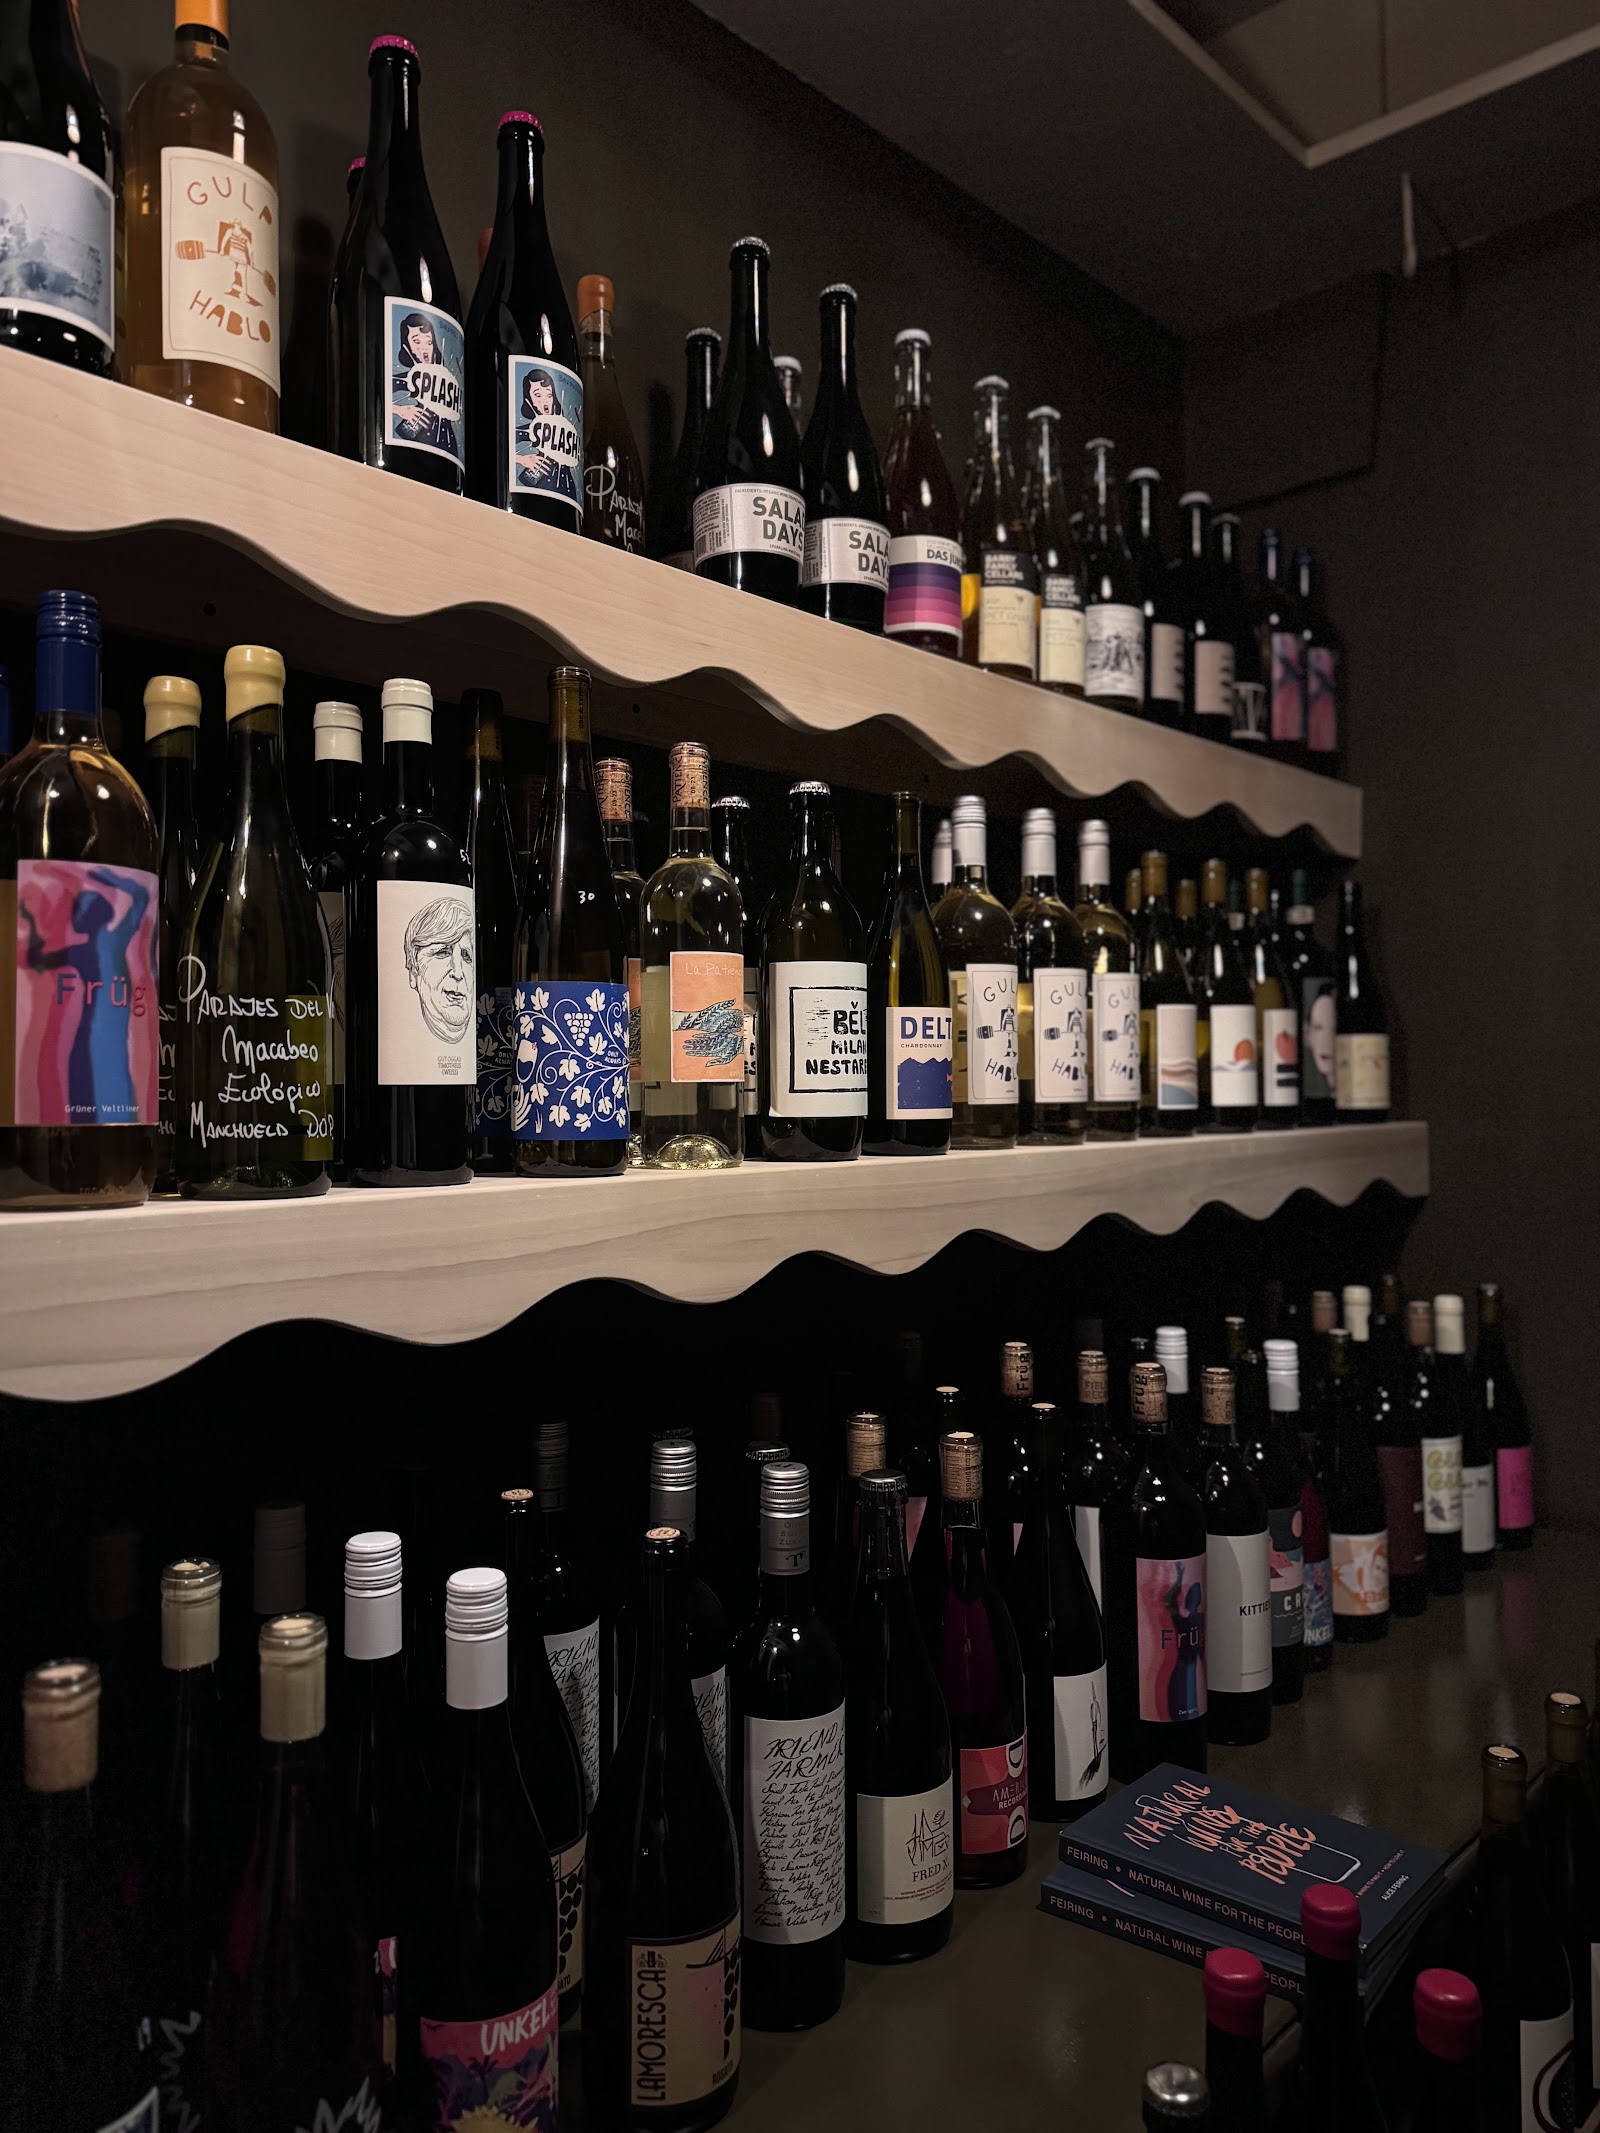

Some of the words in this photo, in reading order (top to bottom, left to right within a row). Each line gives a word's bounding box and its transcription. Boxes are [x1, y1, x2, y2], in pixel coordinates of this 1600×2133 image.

[189, 290, 271, 343] HABLO
[859, 553, 888, 580] DAY
[927, 549, 948, 562] DAS
[578, 890, 595, 904] 30
[57, 974, 146, 1017] Früg
[222, 1025, 318, 1074] Macabeo
[65, 1103, 97, 1114] Grüner
[101, 1103, 140, 1114] Veltliner
[1016, 1353, 1029, 1391] Früg
[1133, 1374, 1147, 1415] Früg
[1161, 1627, 1204, 1650] Frü
[1123, 1779, 1211, 1850] NATURAL
[1173, 1804, 1241, 1853] WINE
[912, 1863, 941, 1882] FRED
[1238, 1822, 1317, 1885] PEOPLE
[1067, 1845, 1109, 1870] FEIRING
[1128, 1868, 1180, 1898] NATURAL
[1182, 1888, 1212, 1910] WINE
[1214, 1902, 1239, 1919] FOR
[1240, 1911, 1265, 1930] THE
[1050, 1895, 1094, 1920] FEIRING
[1115, 1918, 1169, 1947] NATURAL
[1171, 1937, 1203, 1958] WINE
[636, 1969, 667, 2101] LAMORESCA
[712, 2060, 734, 2085] ROSATO
